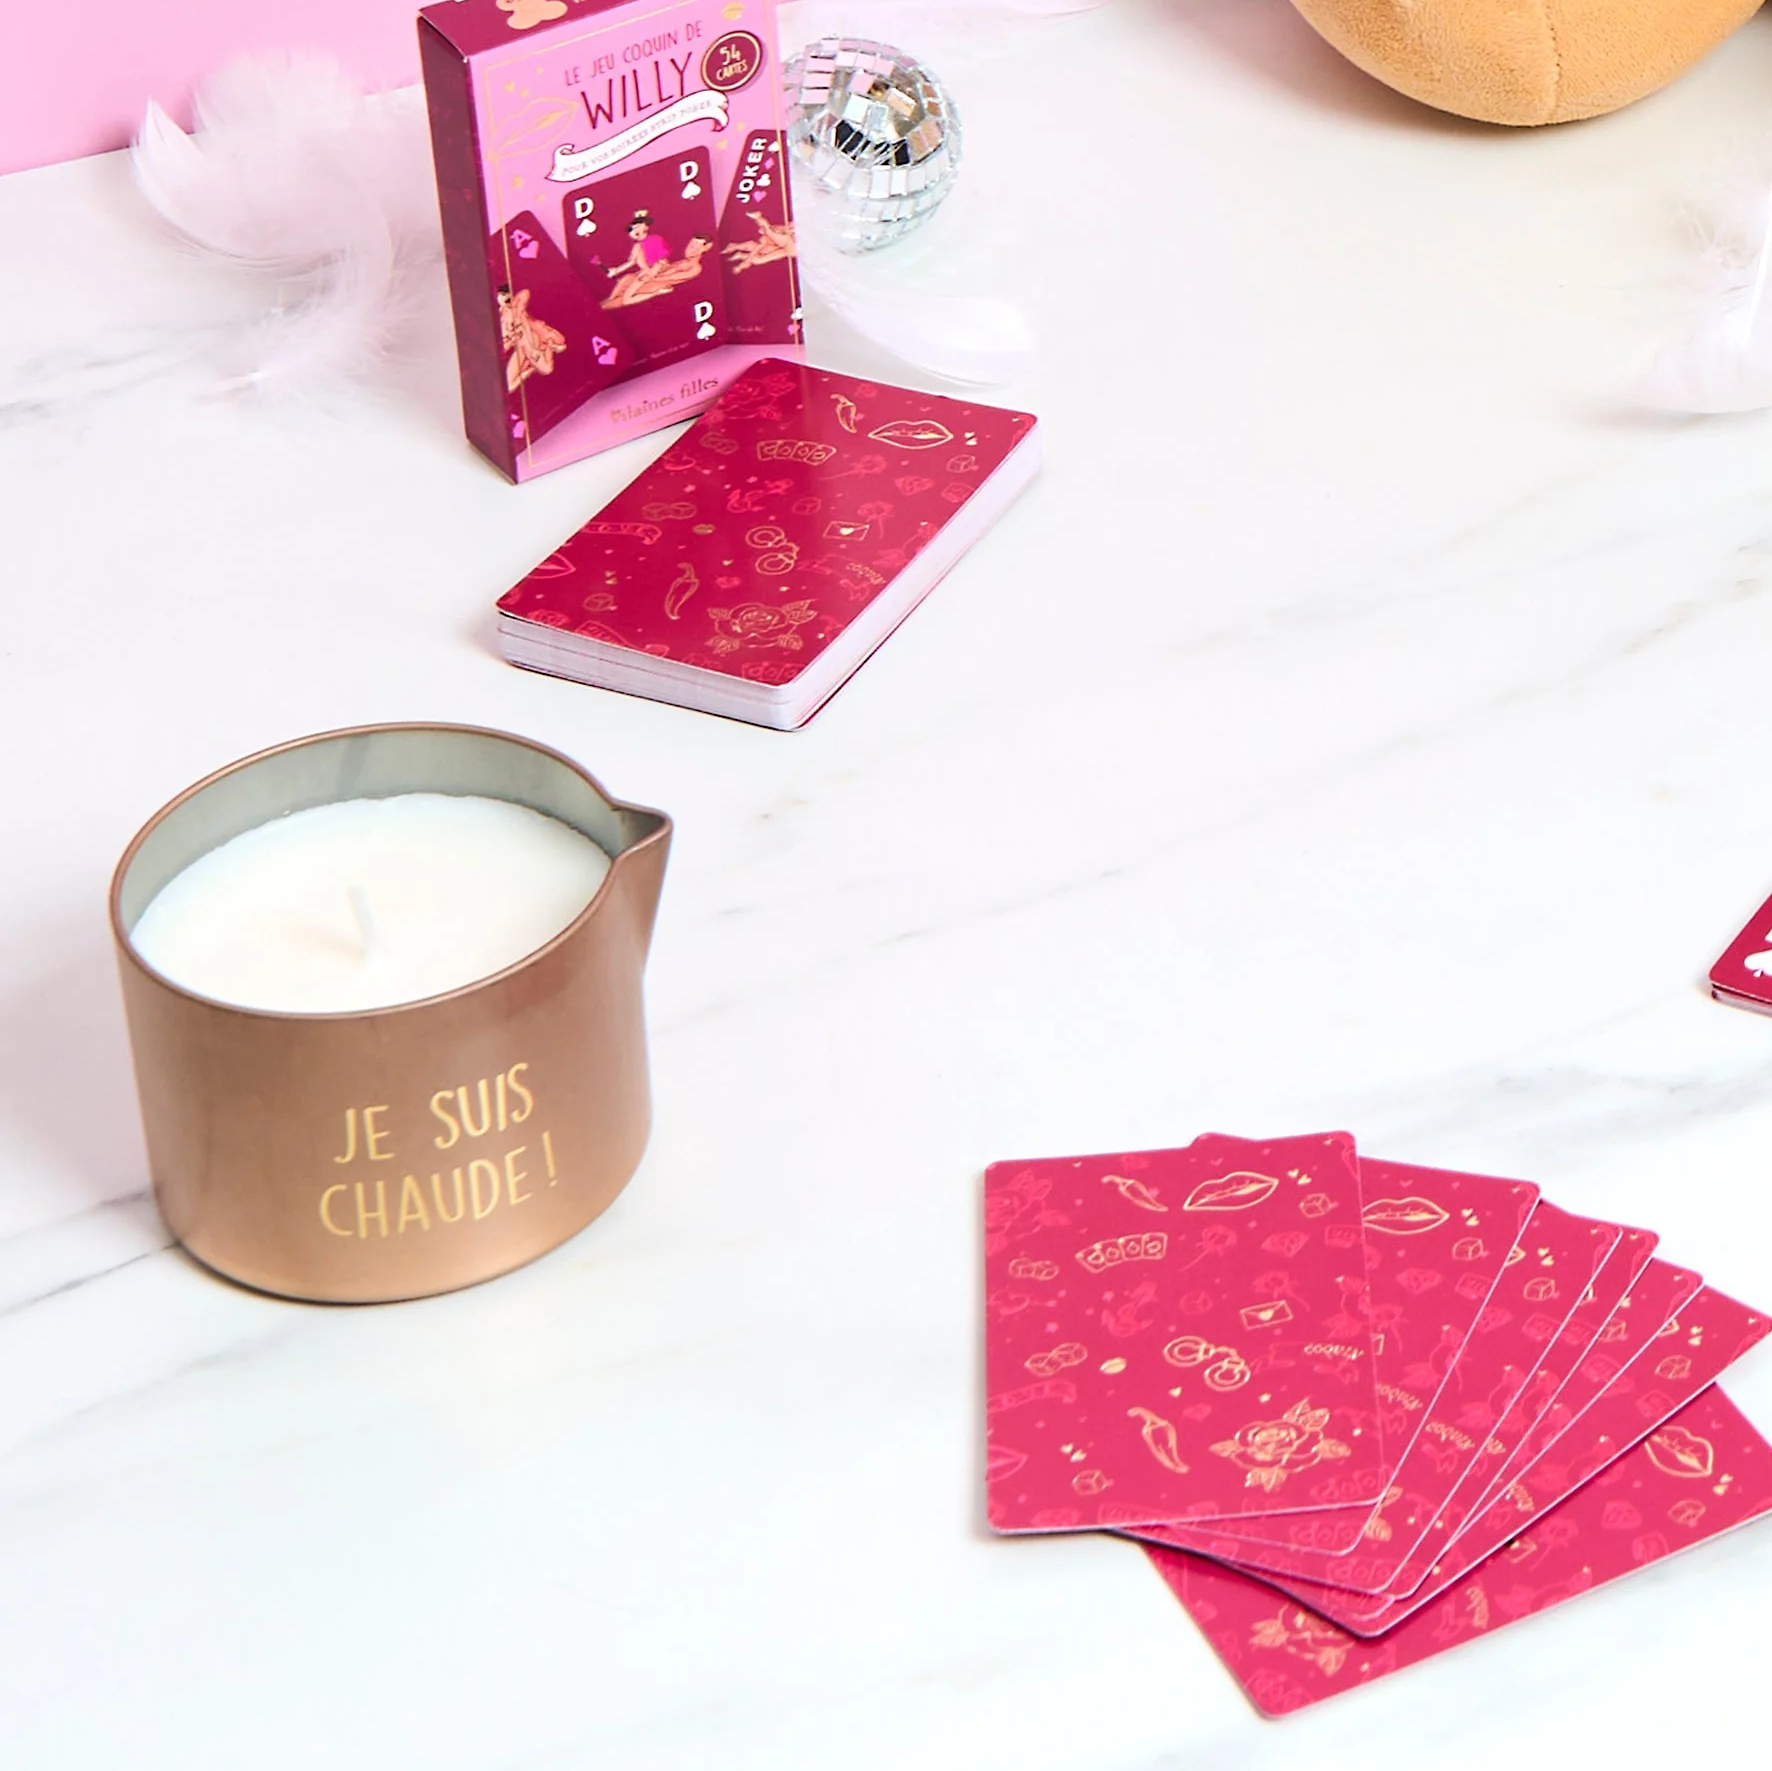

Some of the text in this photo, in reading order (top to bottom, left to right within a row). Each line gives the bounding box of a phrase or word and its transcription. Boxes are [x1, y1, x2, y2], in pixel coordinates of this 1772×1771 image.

[565, 20, 703, 86] LE JEU COQUIN DE
[720, 44, 741, 65] 54
[716, 60, 748, 80] CARTES
[581, 51, 692, 129] WILLY
[680, 160, 699, 182] D
[736, 138, 767, 203] JOKER
[574, 197, 594, 219] D
[510, 229, 533, 249] A
[693, 301, 714, 323] D
[591, 335, 611, 355] A
[681, 377, 718, 398] filles
[333, 1062, 534, 1163] JE SUIS
